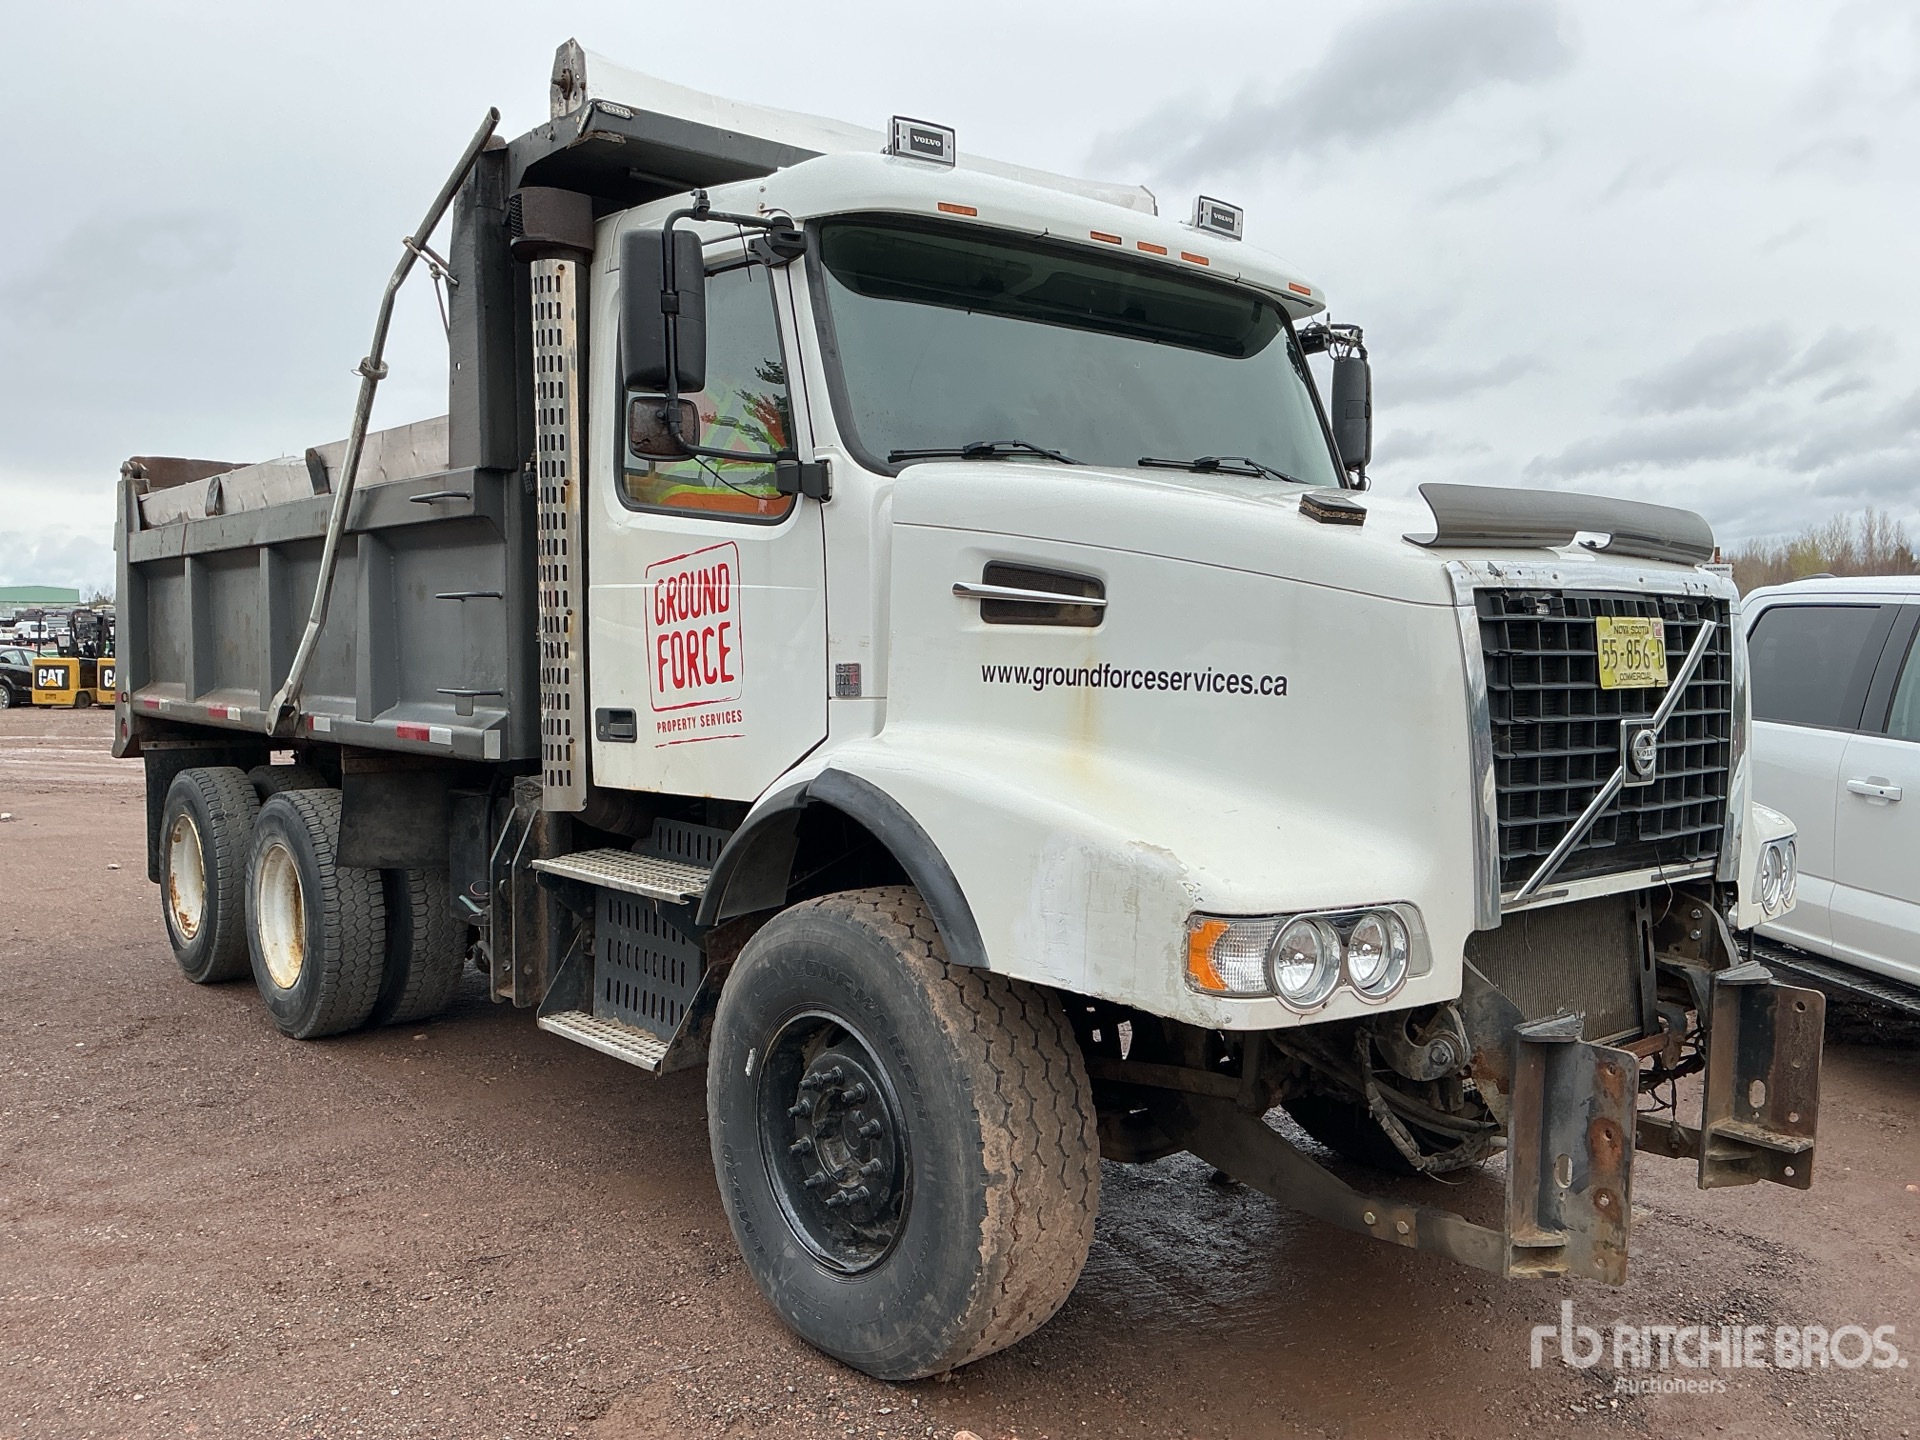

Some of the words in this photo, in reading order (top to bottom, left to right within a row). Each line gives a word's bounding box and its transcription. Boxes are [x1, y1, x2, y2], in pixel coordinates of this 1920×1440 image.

[913, 135, 941, 147] VOLVO
[1213, 212, 1233, 224] VOLVO
[654, 562, 730, 626] GROUND
[1613, 626, 1629, 634] NOVA
[1630, 625, 1650, 635] SCOTIA
[657, 621, 735, 692] FORCE
[38, 668, 65, 687] CAT
[981, 663, 1288, 696] www.groundforceservices.ca
[1620, 672, 1653, 681] COMMERCIAL
[656, 715, 697, 734] PROPERTY
[700, 709, 743, 728] SERVICES
